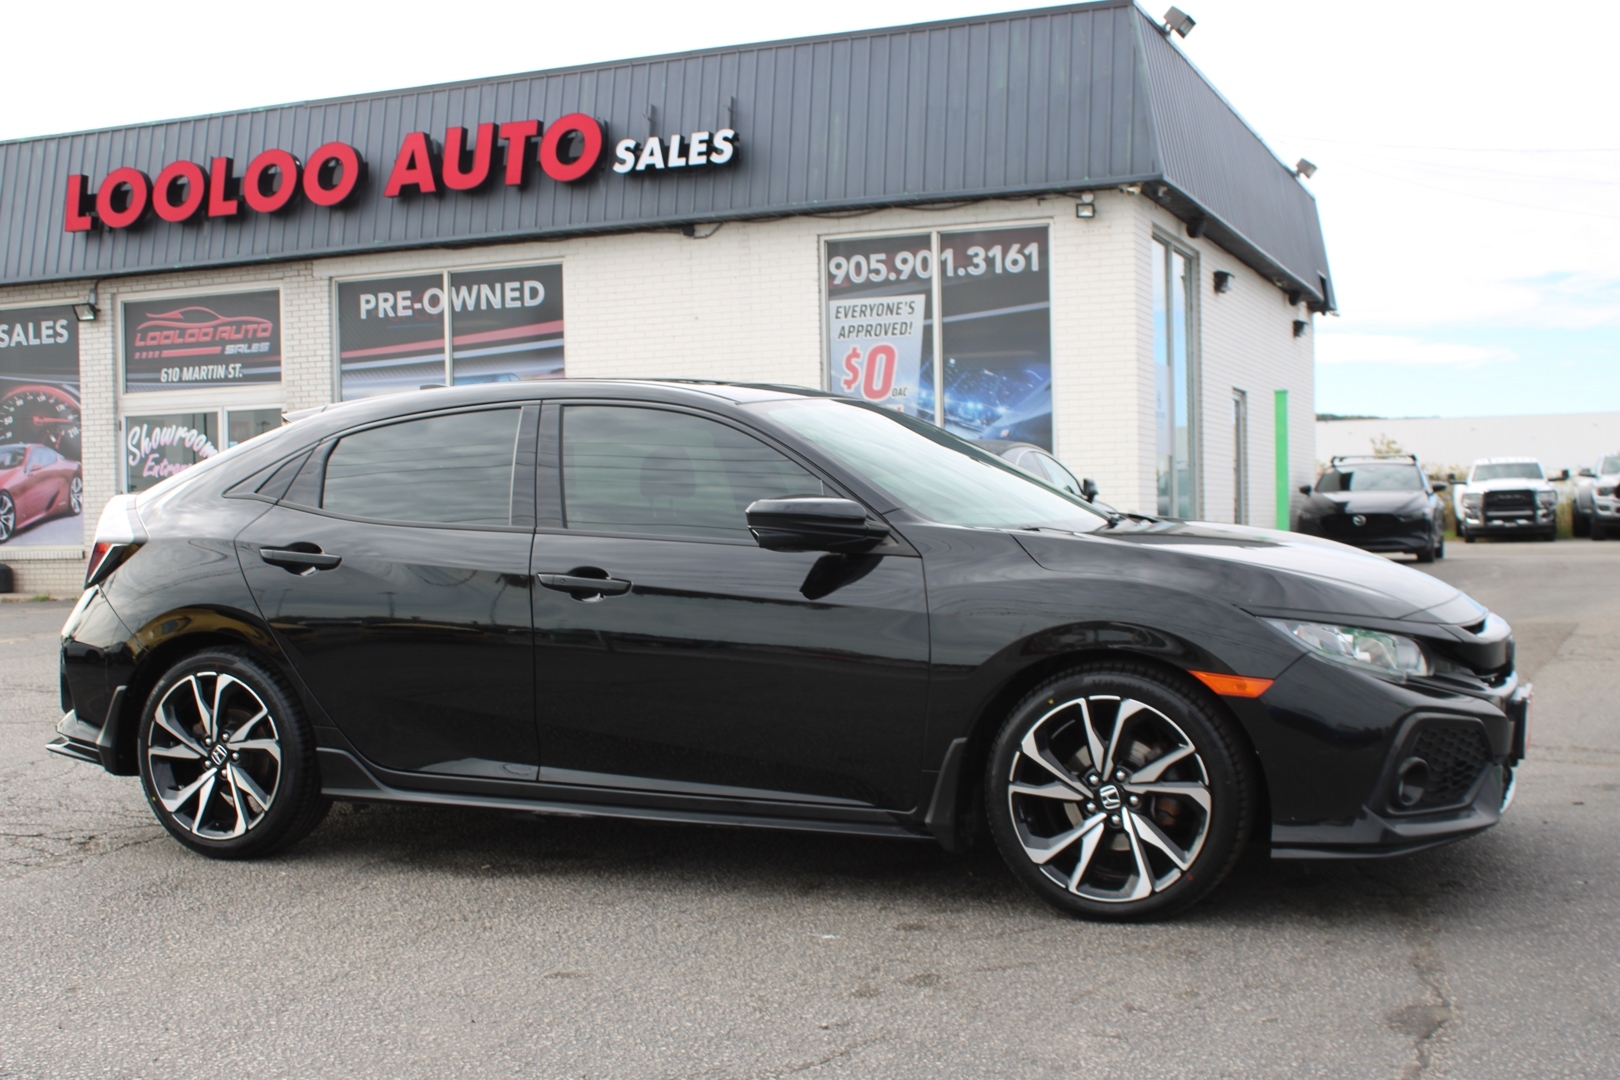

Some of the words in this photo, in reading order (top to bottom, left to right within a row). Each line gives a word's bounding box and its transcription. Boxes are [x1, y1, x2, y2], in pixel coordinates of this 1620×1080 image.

[65, 141, 361, 232] LOOLOO
[384, 112, 602, 197] AUTO
[613, 128, 735, 174] SALES
[828, 242, 1040, 285] 905.901.3161
[359, 280, 546, 319] PRE-OWNED
[835, 301, 916, 320] EVERYONE'S
[0, 319, 69, 348] SALES
[134, 328, 214, 347] LOOLOO
[215, 323, 273, 341] AUTO
[837, 321, 914, 339] APPROVED!
[224, 342, 271, 355] SALES
[160, 367, 180, 383] 610
[182, 364, 226, 381] MARTIN
[227, 363, 243, 379] ST.
[843, 344, 897, 400] $0
